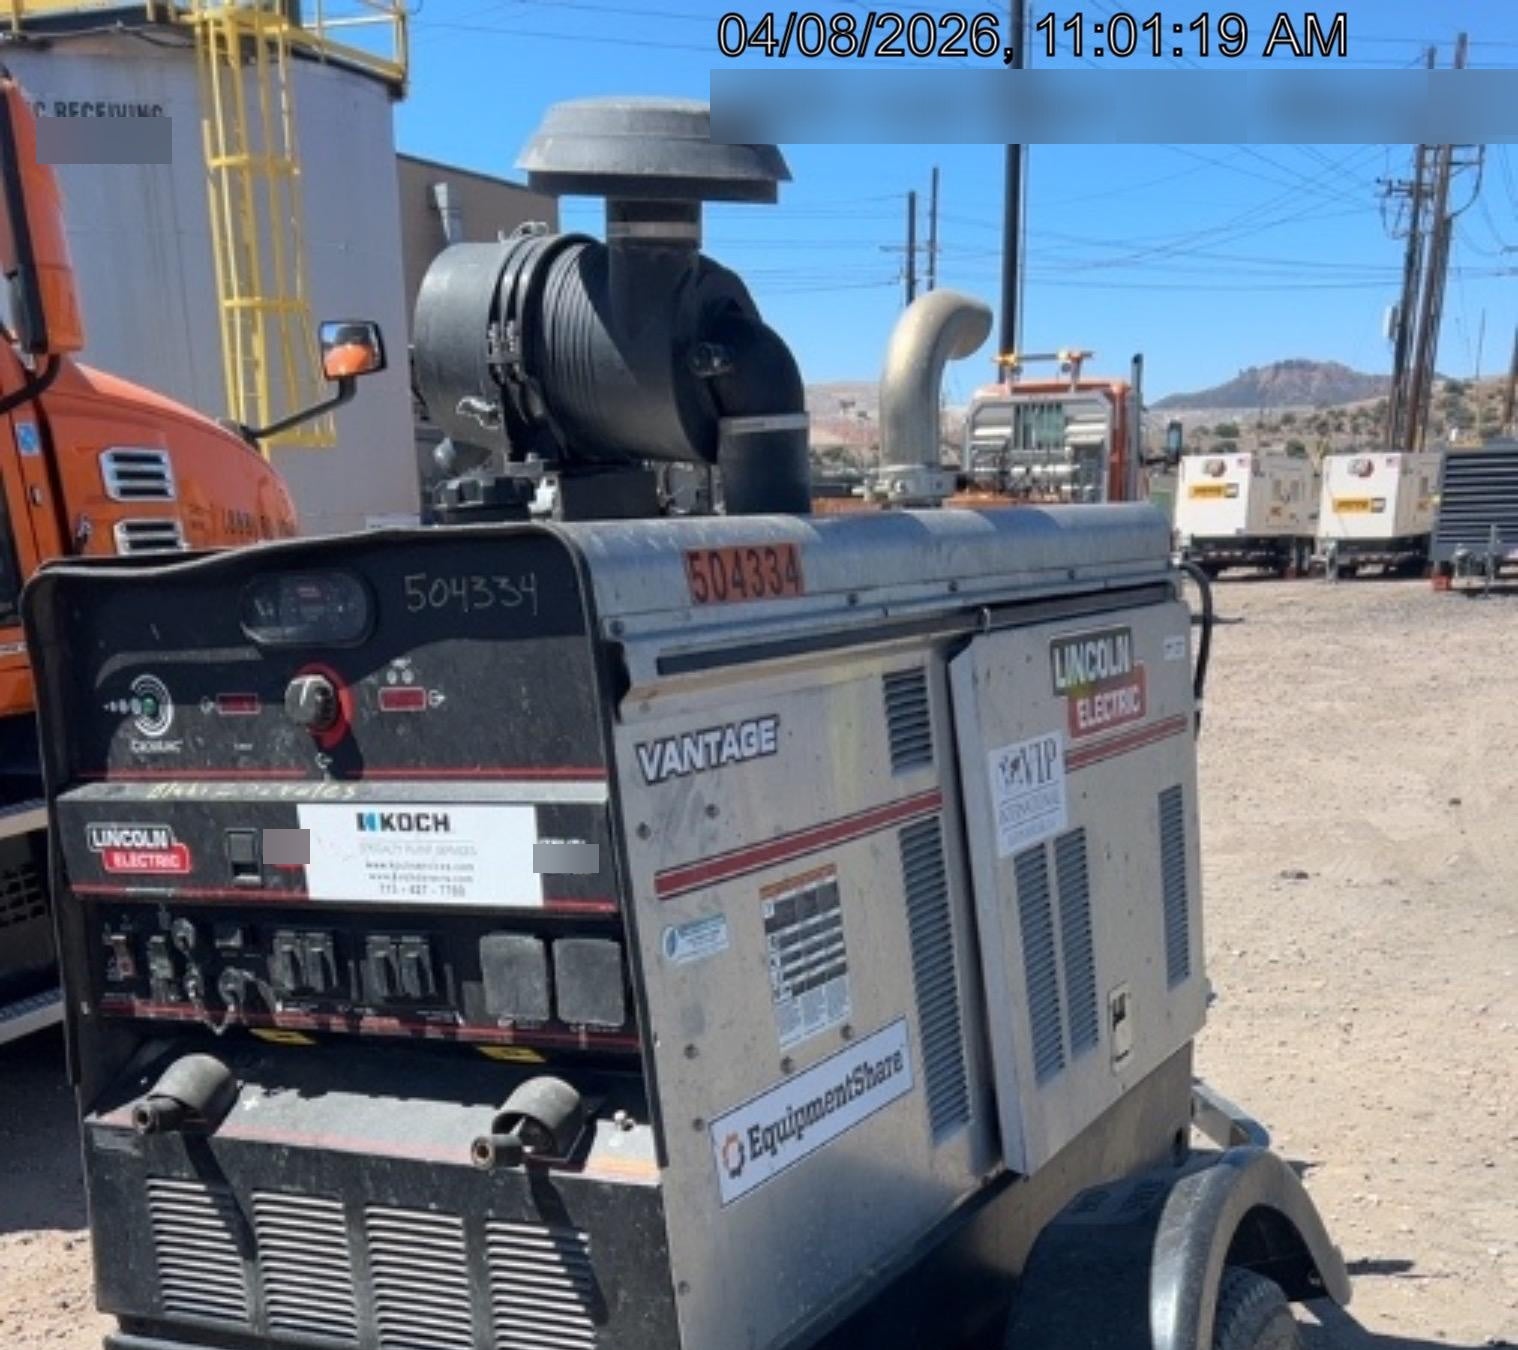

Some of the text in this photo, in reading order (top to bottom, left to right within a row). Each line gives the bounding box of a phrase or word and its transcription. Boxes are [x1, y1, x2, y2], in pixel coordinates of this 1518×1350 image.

[404, 572, 538, 616] 504334
[687, 543, 803, 603] 504334
[1053, 633, 1131, 688] LINCOLN
[1076, 684, 1141, 729] ELECTRIC
[635, 716, 779, 785] VANTAGE
[91, 828, 168, 850] LINCOLN
[380, 812, 451, 832] KOCH
[112, 851, 181, 869] ELECTRIC
[747, 1050, 904, 1161] EquipmentShare
